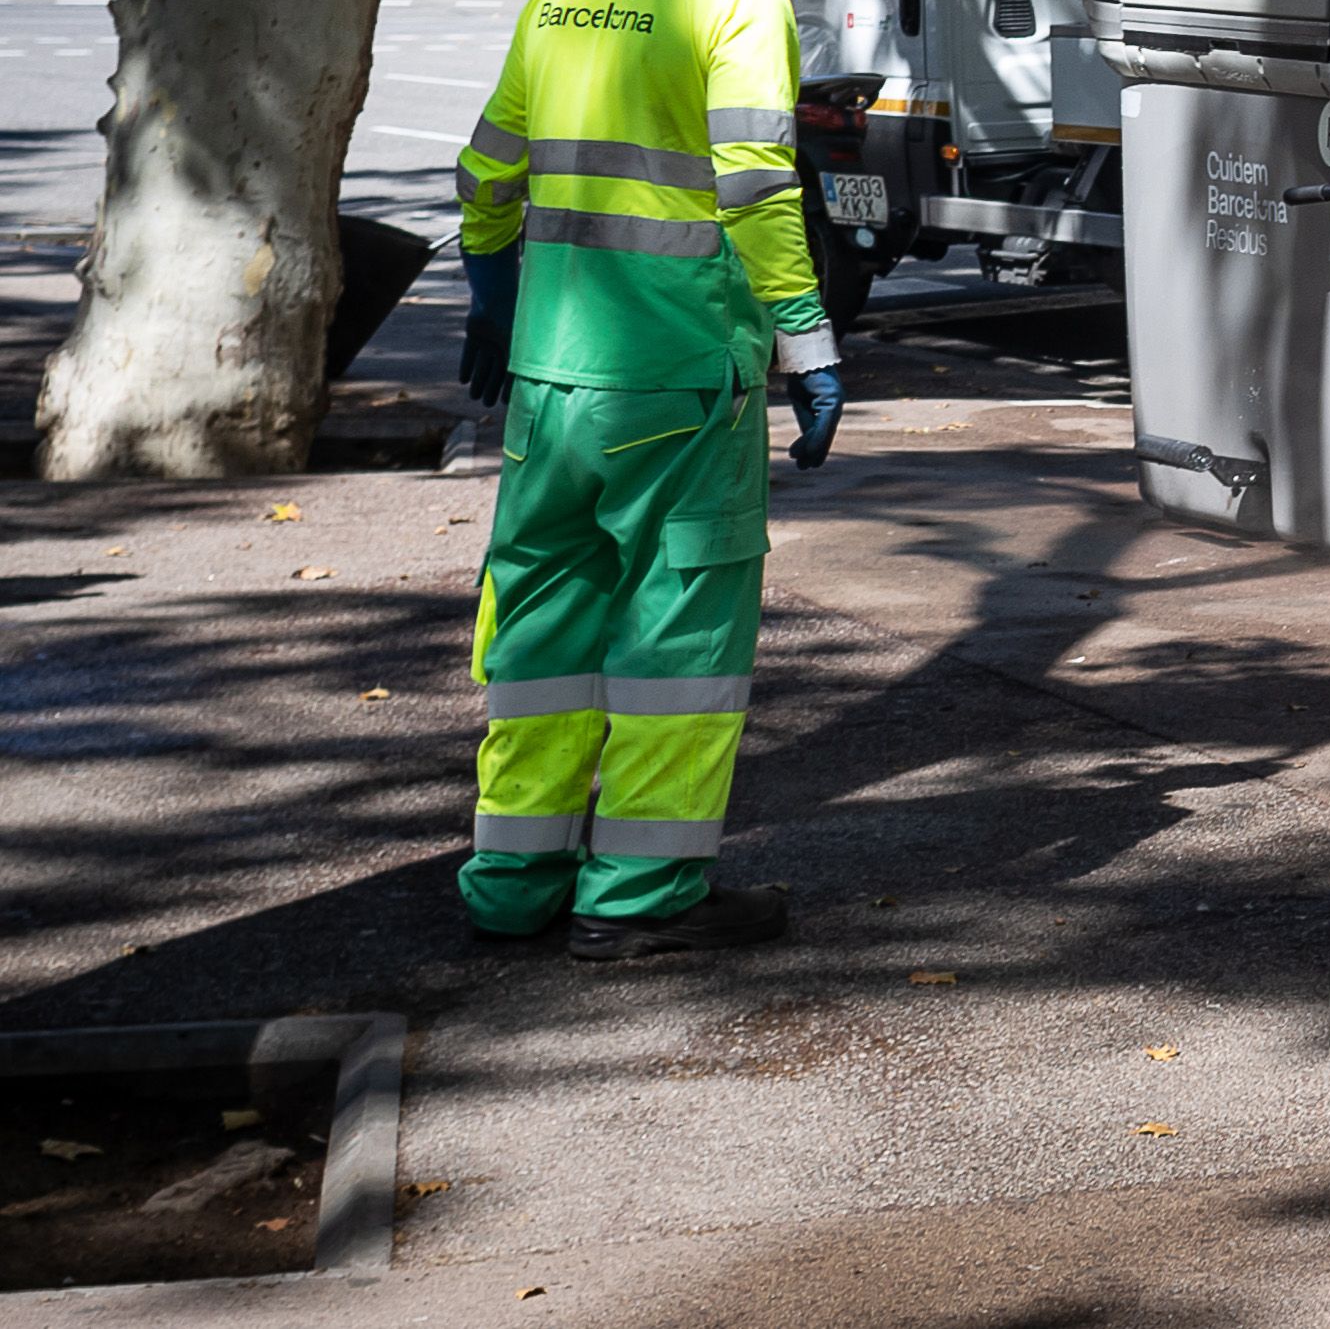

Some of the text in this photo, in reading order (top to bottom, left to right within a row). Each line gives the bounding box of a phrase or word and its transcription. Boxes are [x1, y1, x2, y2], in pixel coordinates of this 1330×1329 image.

[538, 2, 654, 34] Barcelona
[1207, 151, 1268, 186] Cuidem
[835, 177, 883, 198] 2303
[1207, 185, 1289, 224] Barcelona
[1205, 219, 1268, 256] Residus
